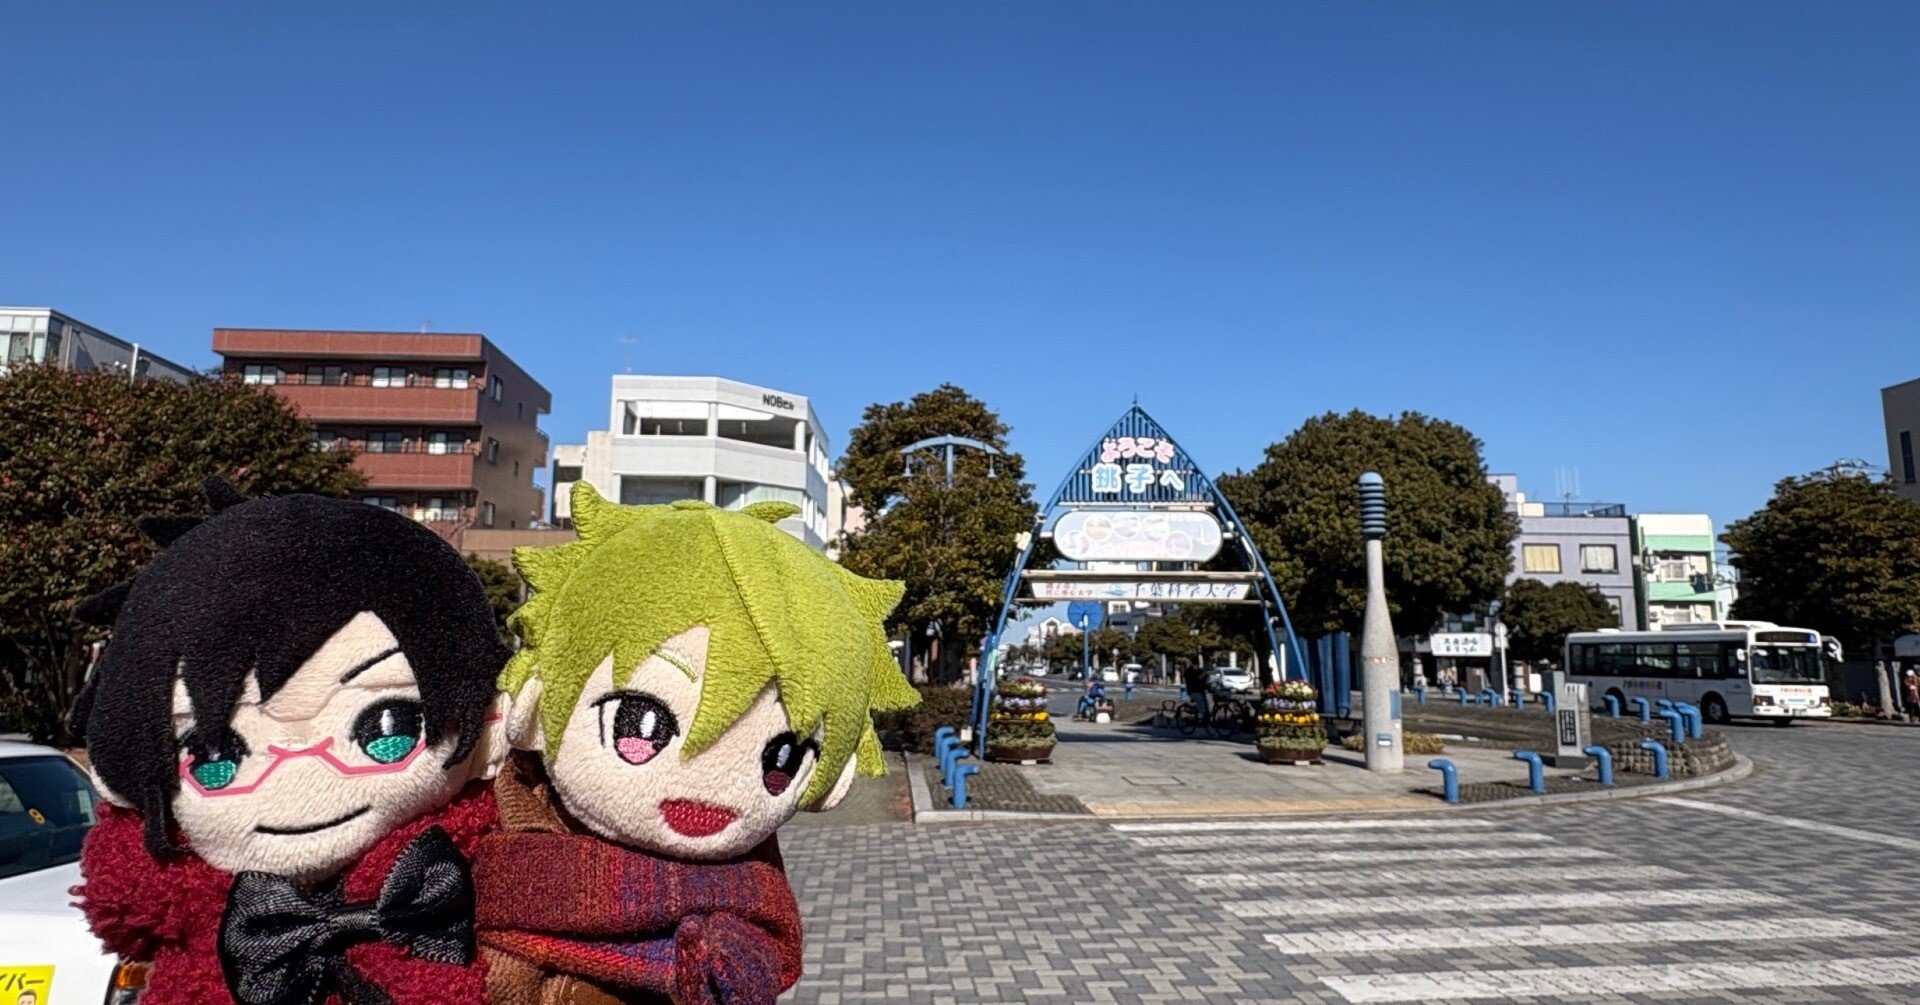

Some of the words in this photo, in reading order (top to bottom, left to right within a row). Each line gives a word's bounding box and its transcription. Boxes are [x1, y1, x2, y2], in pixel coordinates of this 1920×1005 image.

[1101, 437, 1174, 464] ようこそ
[1092, 463, 1184, 493] 銚子へ
[1135, 582, 1237, 597] 千葉科学大学
